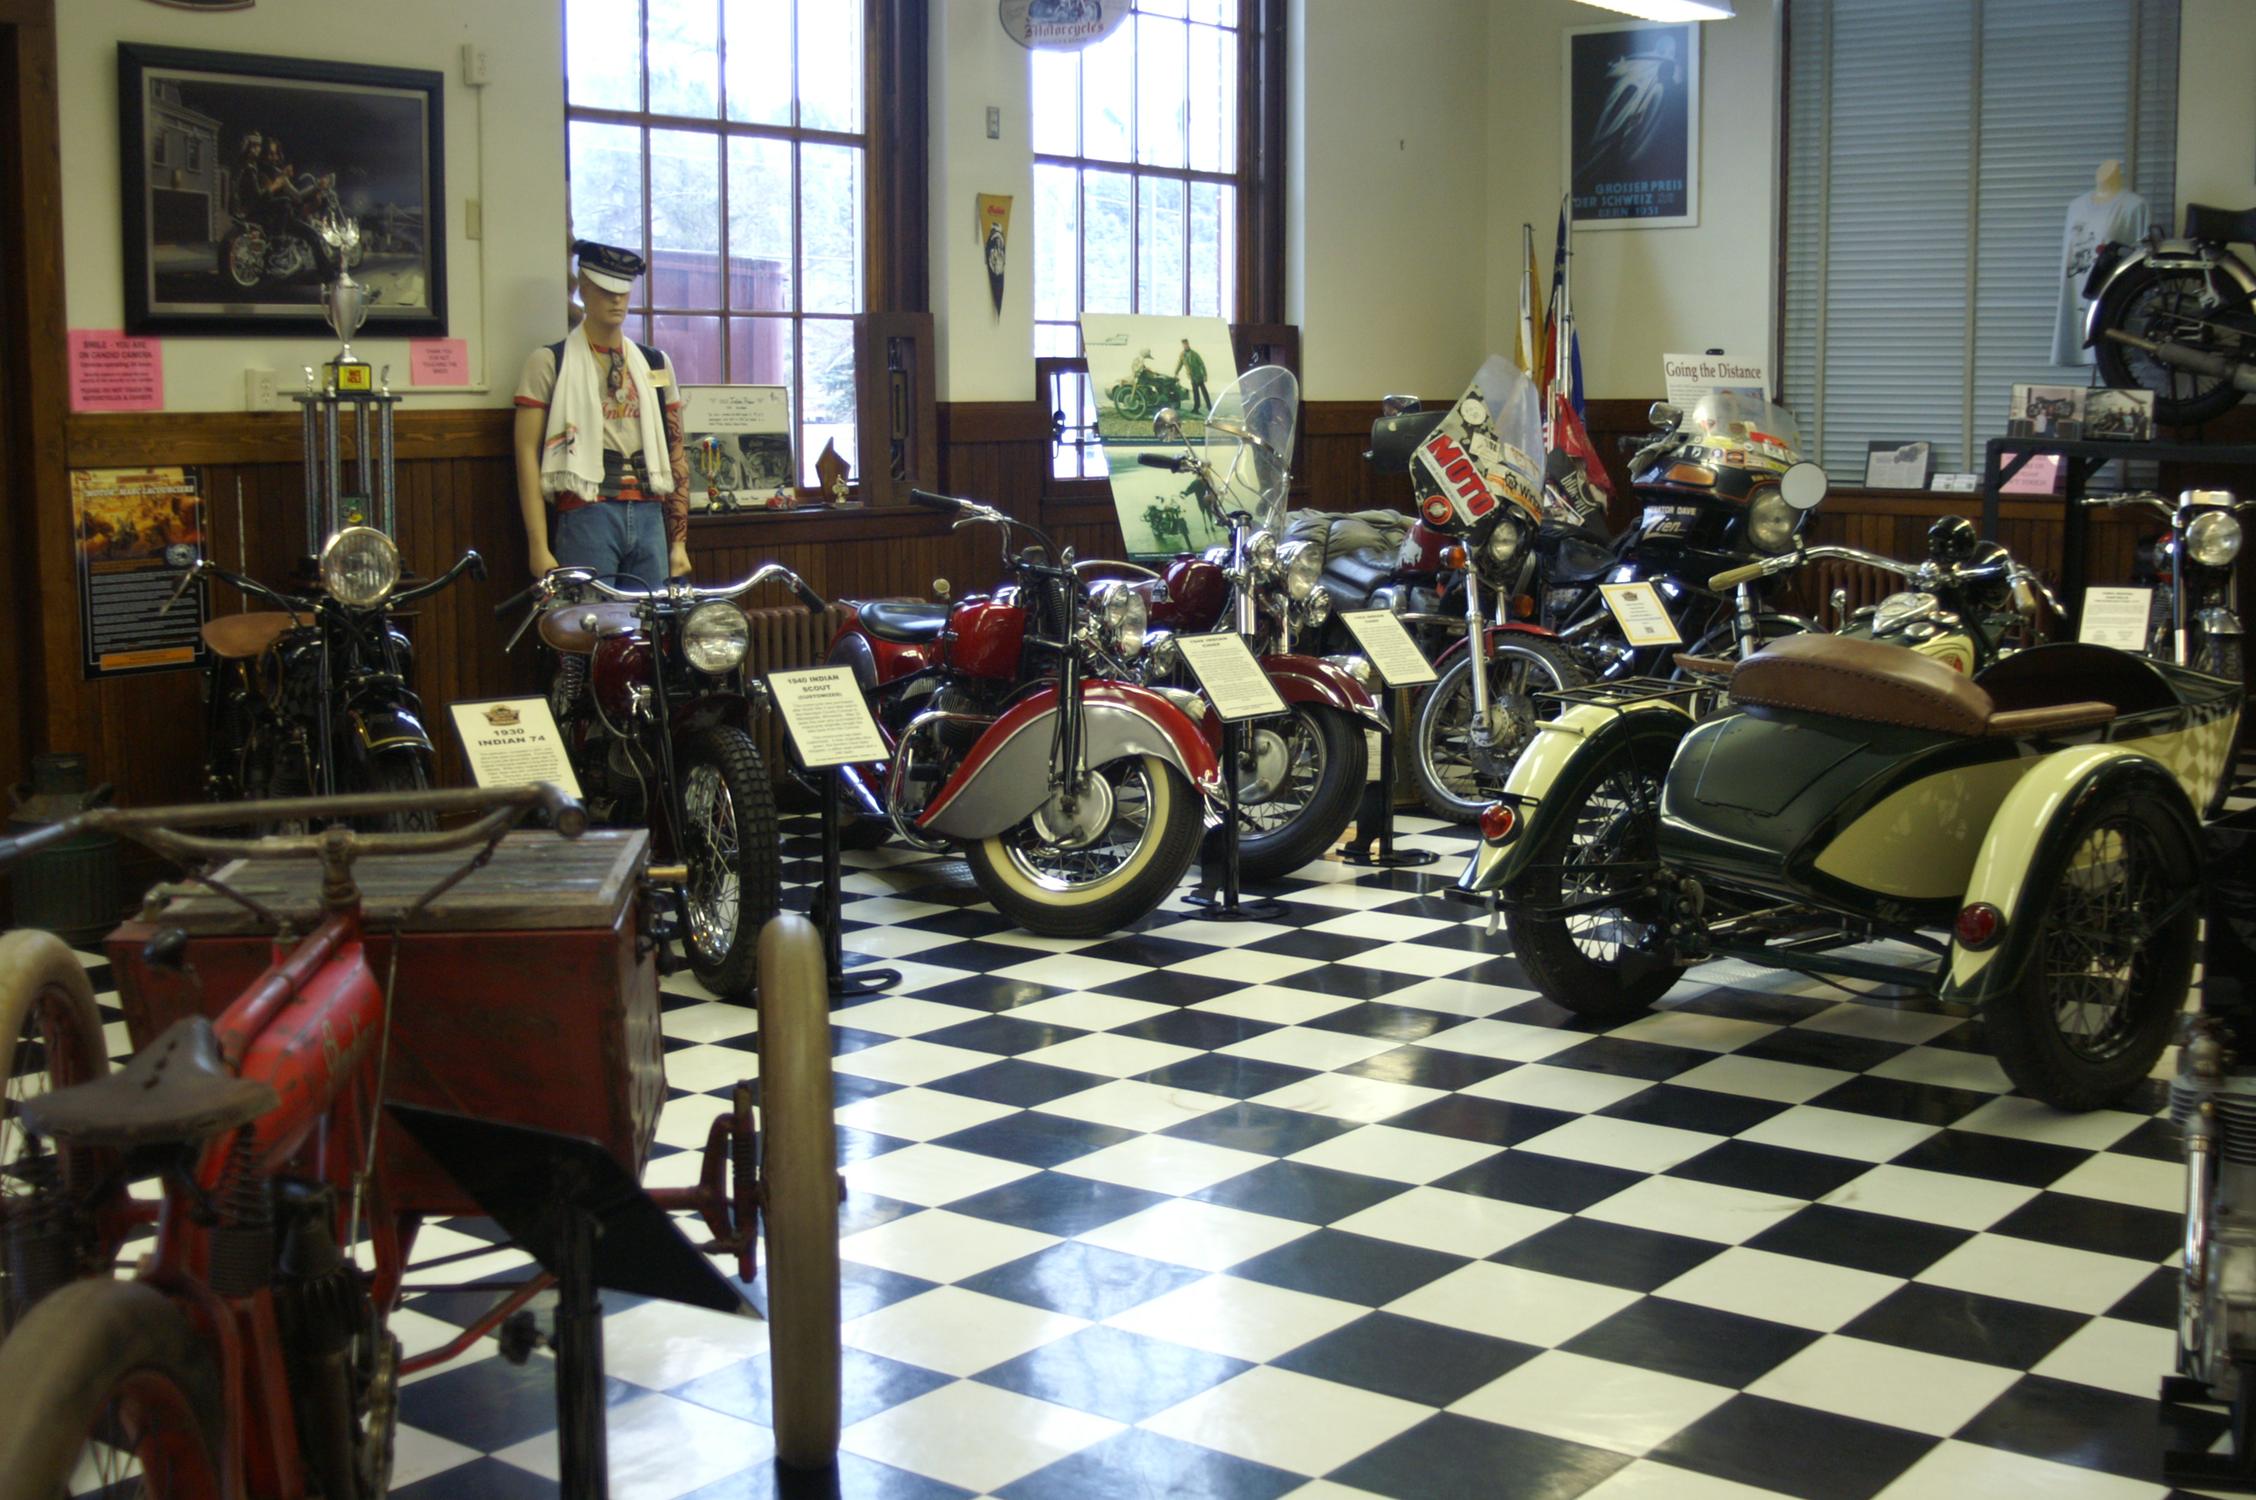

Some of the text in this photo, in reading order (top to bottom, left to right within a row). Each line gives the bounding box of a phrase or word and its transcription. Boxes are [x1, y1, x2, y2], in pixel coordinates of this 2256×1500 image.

[1595, 179, 1683, 195] GROSSER PREIS
[1574, 196, 1597, 208] DER
[1601, 193, 1653, 207] SCHWEIZ
[1665, 361, 1762, 382] Going the Distance
[1425, 433, 1496, 518] MOTO
[1676, 505, 1697, 516] DAVE
[787, 674, 840, 685] 1940 INDIAN
[802, 684, 831, 693] SCOUT
[493, 728, 525, 738] 1930
[478, 735, 546, 747] INDIAN 74
